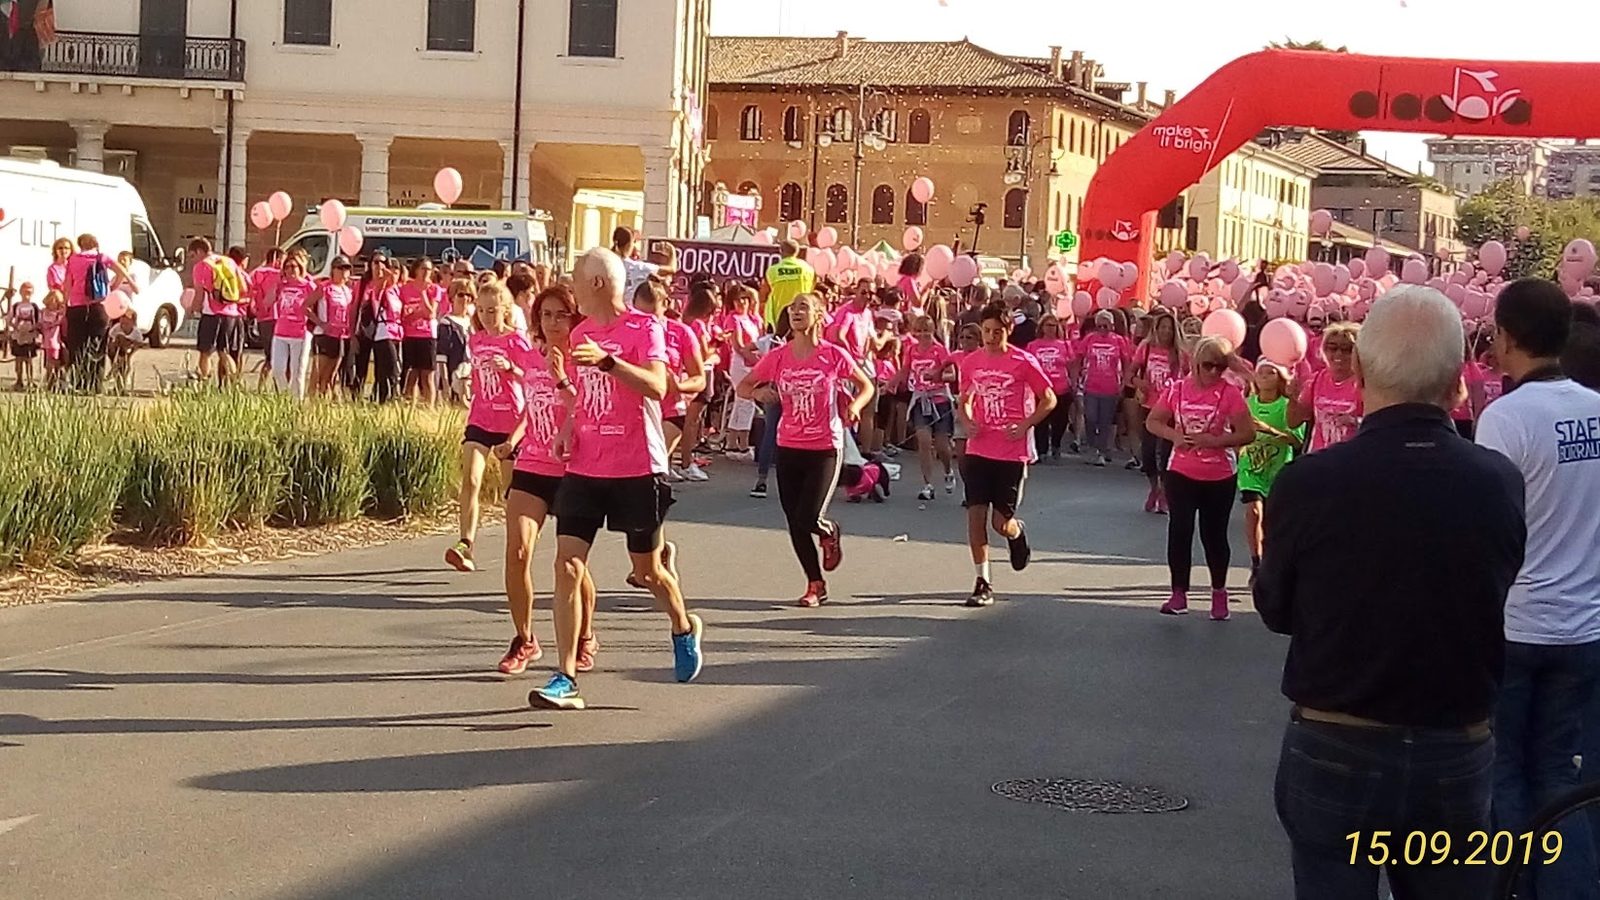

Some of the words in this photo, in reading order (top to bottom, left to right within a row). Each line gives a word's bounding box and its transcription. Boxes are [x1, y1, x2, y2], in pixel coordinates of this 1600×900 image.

[1153, 124, 1192, 138] make
[179, 197, 218, 215] GARIBALD
[365, 217, 397, 226] CROCE
[399, 218, 437, 227] BIANCA
[440, 219, 488, 228] ITALIANA
[20, 217, 62, 249] LILT
[395, 226, 428, 234] MOBILE
